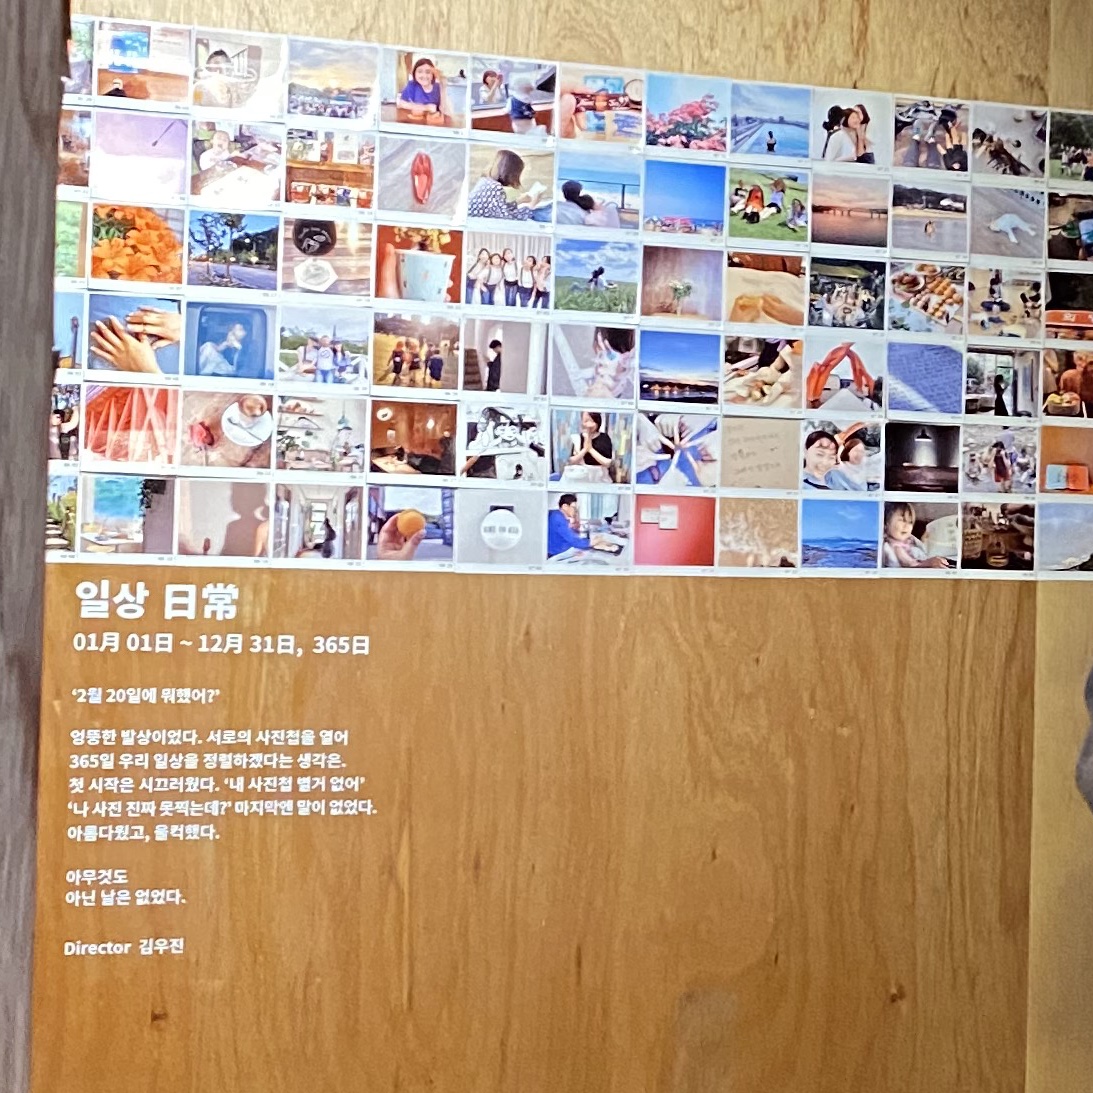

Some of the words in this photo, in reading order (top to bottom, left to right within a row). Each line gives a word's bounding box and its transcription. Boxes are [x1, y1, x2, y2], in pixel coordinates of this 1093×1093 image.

[75, 579, 150, 620] 일상
[164, 582, 240, 622] 日常
[72, 631, 120, 653] 01月
[126, 632, 174, 654] 01日
[197, 633, 243, 655] 12月
[249, 634, 304, 658] 31日,
[312, 635, 370, 656] 365日
[105, 687, 158, 705] 20일에
[69, 728, 118, 746] 엉뚱한
[120, 728, 203, 746] 발상이었다.
[205, 729, 252, 746] 서로의
[255, 729, 316, 746] 사진첩을
[318, 729, 349, 746] 열어
[69, 752, 115, 770] 365일
[118, 752, 150, 770] 우리
[152, 752, 200, 770] 일상을
[202, 752, 294, 770] 정렬하겠다는
[296, 752, 347, 769] 생각은.
[68, 776, 85, 794] 첫
[88, 776, 135, 794] 시작은
[138, 776, 220, 794] 시끄러웠다.
[247, 775, 293, 793] 사진첩
[296, 775, 326, 793] 별거
[91, 800, 123, 818] 사진
[125, 800, 157, 818] 진짜
[234, 799, 294, 817] 마지막엔
[296, 799, 326, 816] 말이
[328, 798, 378, 816] 없었다.
[67, 824, 151, 843] 아름다웠고,
[153, 823, 220, 842] 울컥했다.
[65, 868, 129, 886] 아무것도
[65, 889, 96, 907] 아닌
[100, 888, 132, 907] 날은
[134, 888, 186, 906] 없었다.
[63, 940, 132, 956] Director
[138, 937, 185, 956] 김우진
